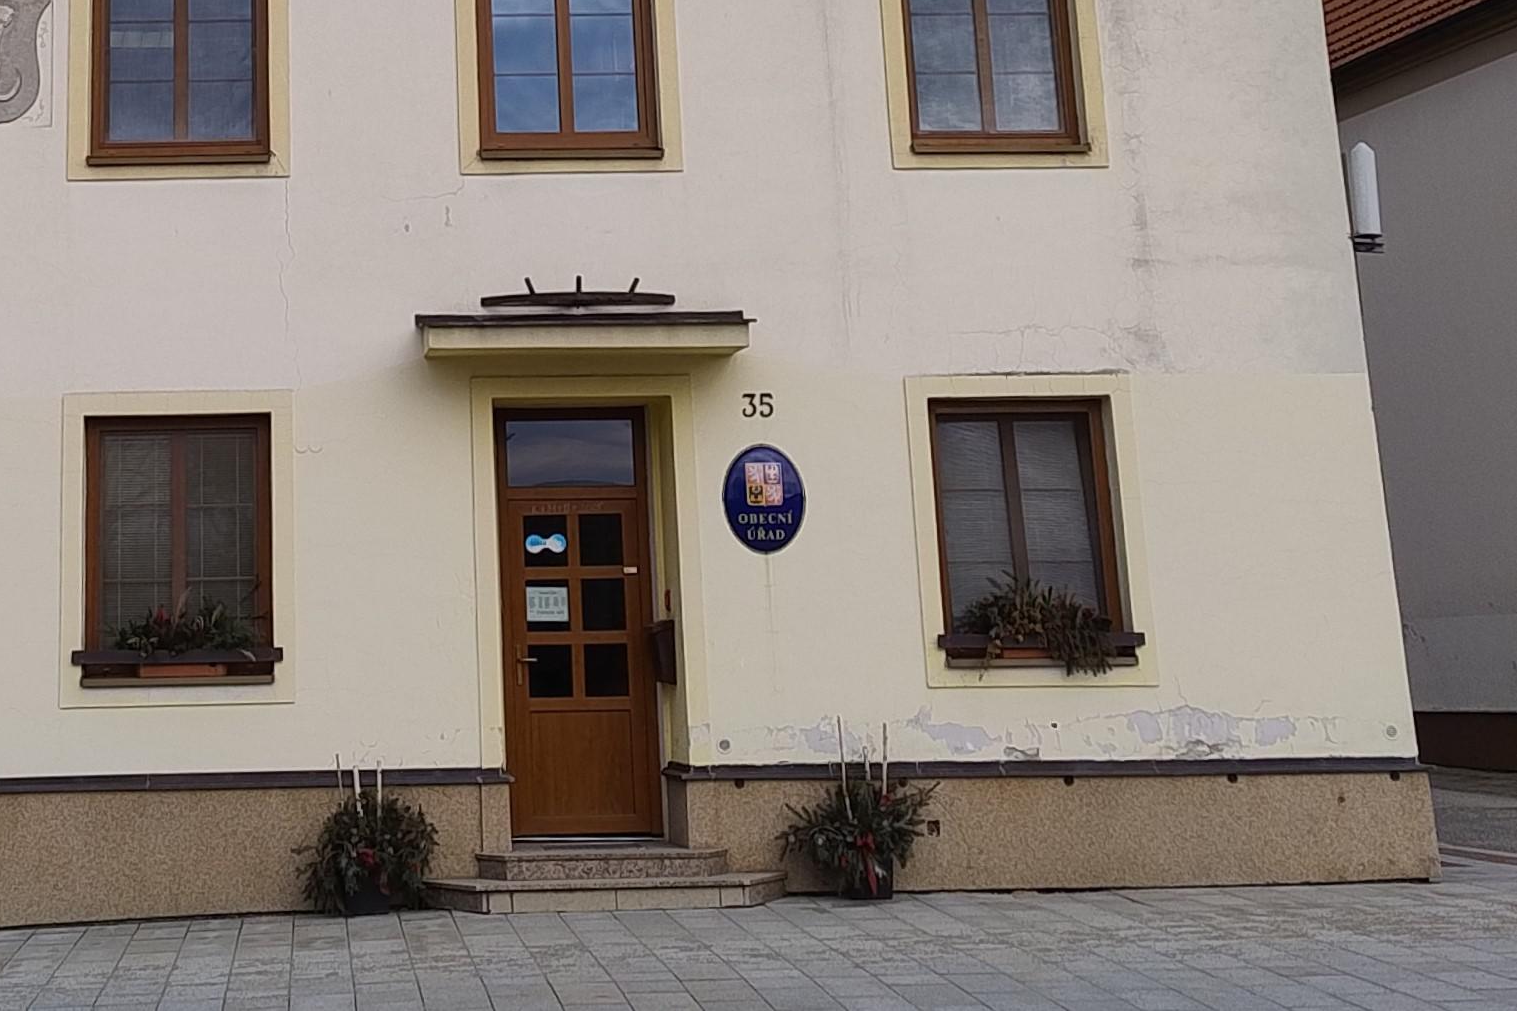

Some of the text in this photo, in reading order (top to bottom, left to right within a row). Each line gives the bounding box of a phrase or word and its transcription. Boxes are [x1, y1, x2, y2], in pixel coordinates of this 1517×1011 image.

[741, 393, 774, 418] 35
[738, 510, 793, 524] OBECNÍ
[747, 527, 786, 540] ÚŘAD
